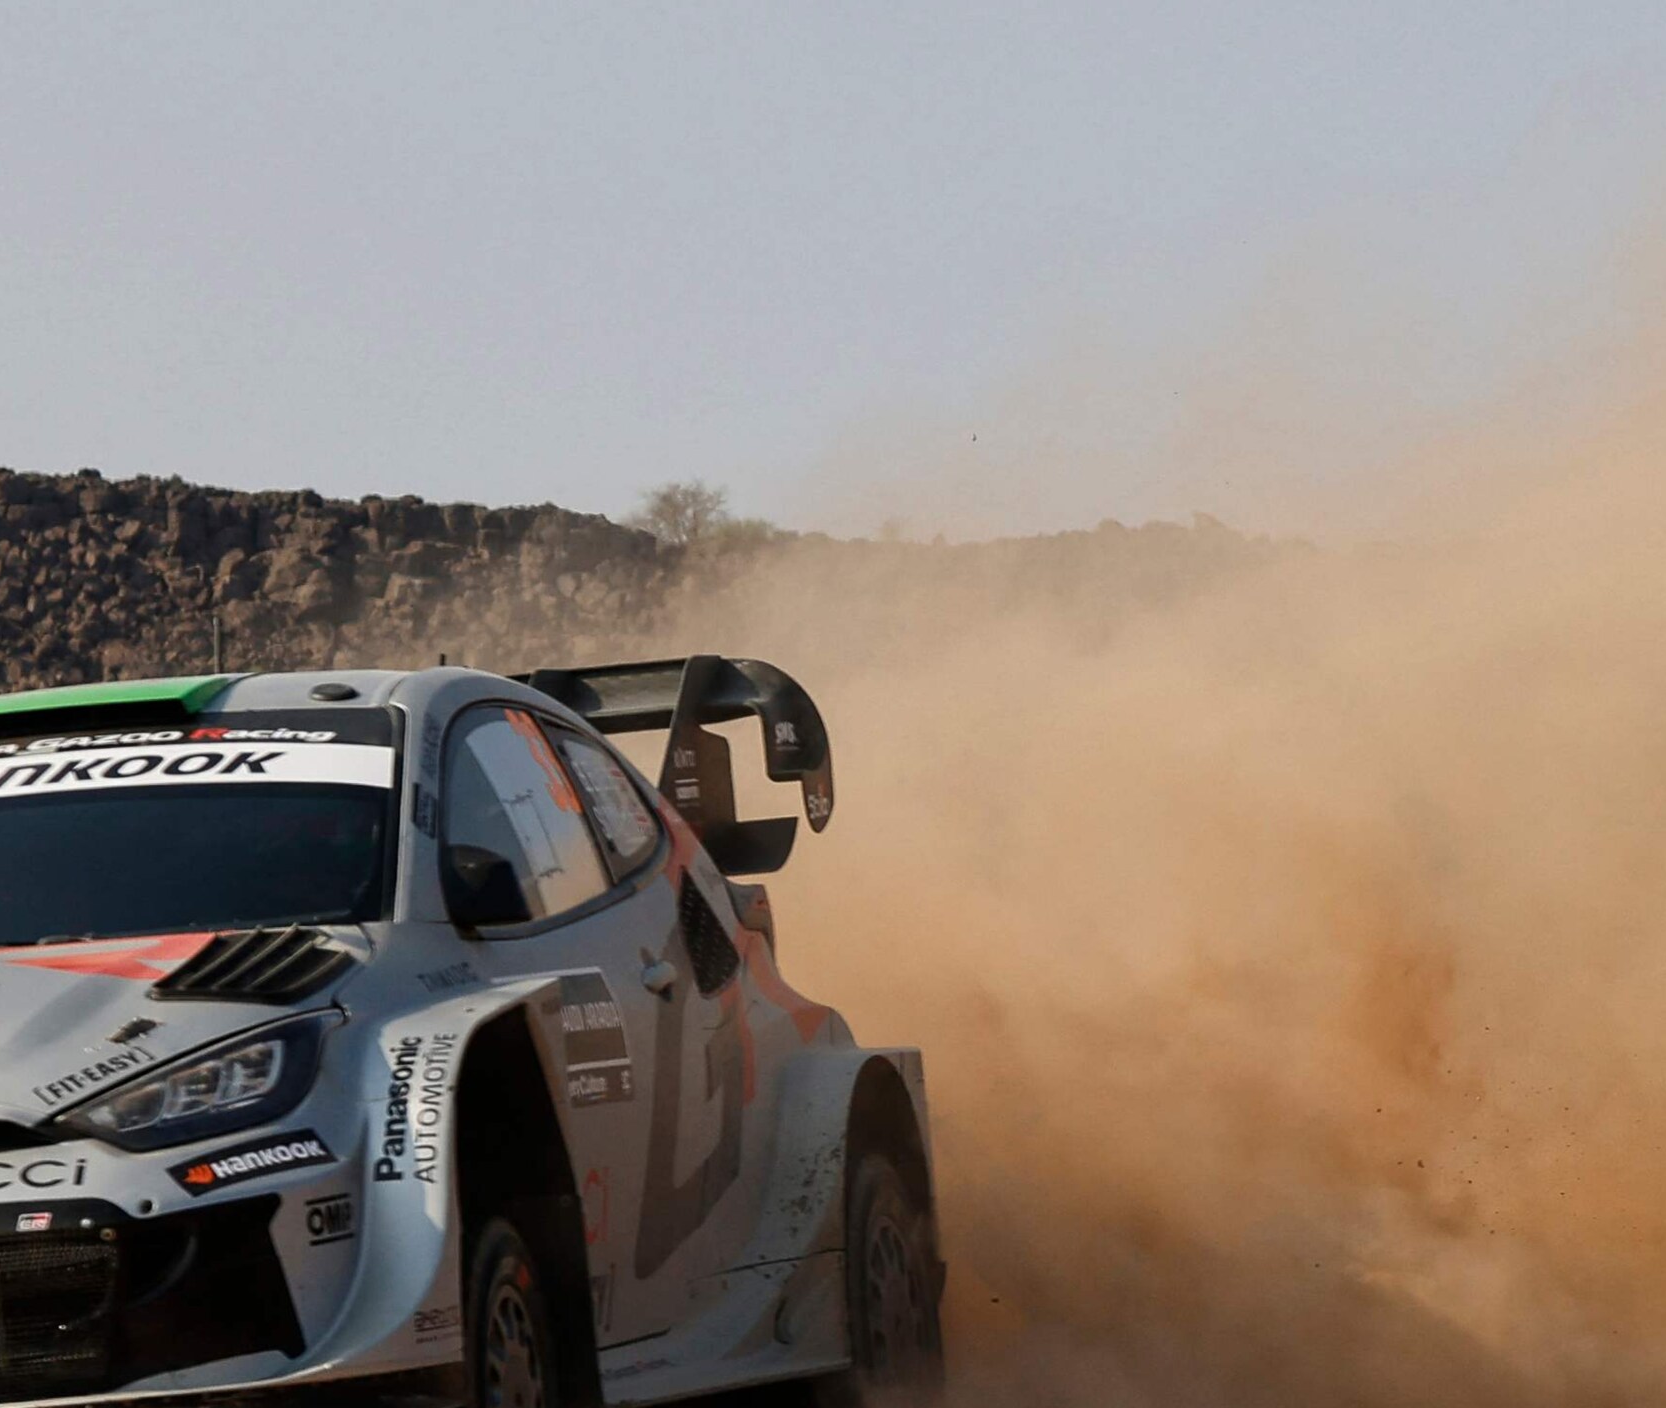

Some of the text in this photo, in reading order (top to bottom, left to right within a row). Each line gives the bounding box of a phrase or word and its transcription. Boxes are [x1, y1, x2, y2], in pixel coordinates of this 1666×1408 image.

[27, 730, 183, 753] GAZOO
[189, 727, 337, 743] Racing
[373, 1036, 423, 1182] Panasonic
[413, 1033, 457, 1183] AUTOMOTIVE
[307, 1201, 353, 1236] OMP
